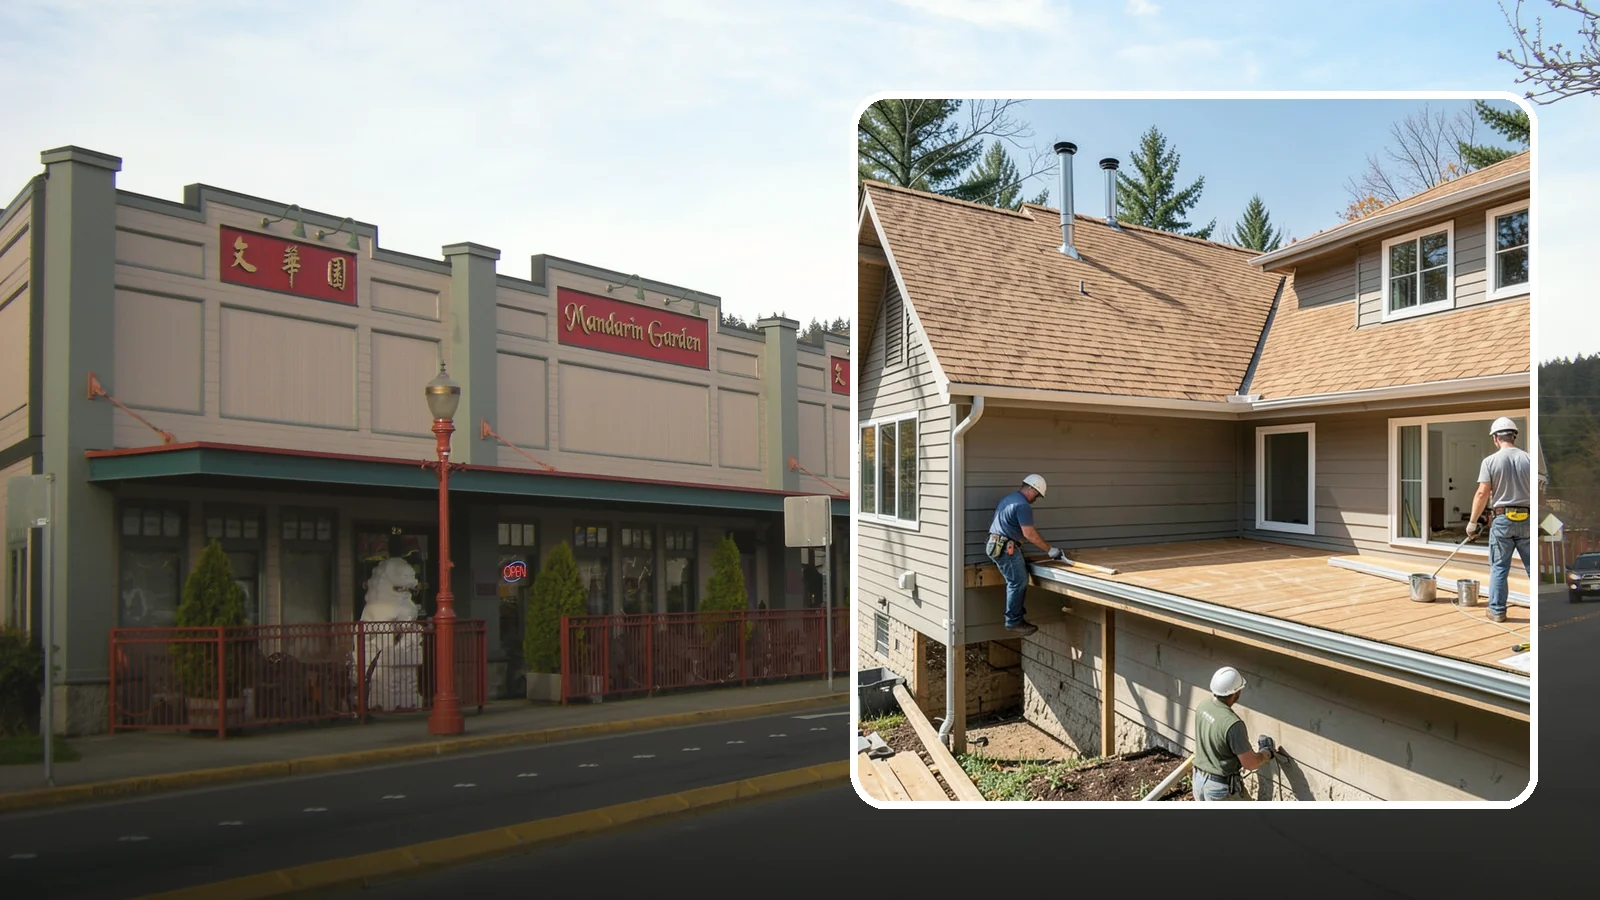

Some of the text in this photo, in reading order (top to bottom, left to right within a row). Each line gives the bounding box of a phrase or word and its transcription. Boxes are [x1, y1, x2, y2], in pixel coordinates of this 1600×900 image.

[231, 235, 346, 290] 文華園
[564, 302, 701, 352] Mandarin Garden
[834, 362, 846, 386] 文
[503, 565, 527, 578] OPEN
